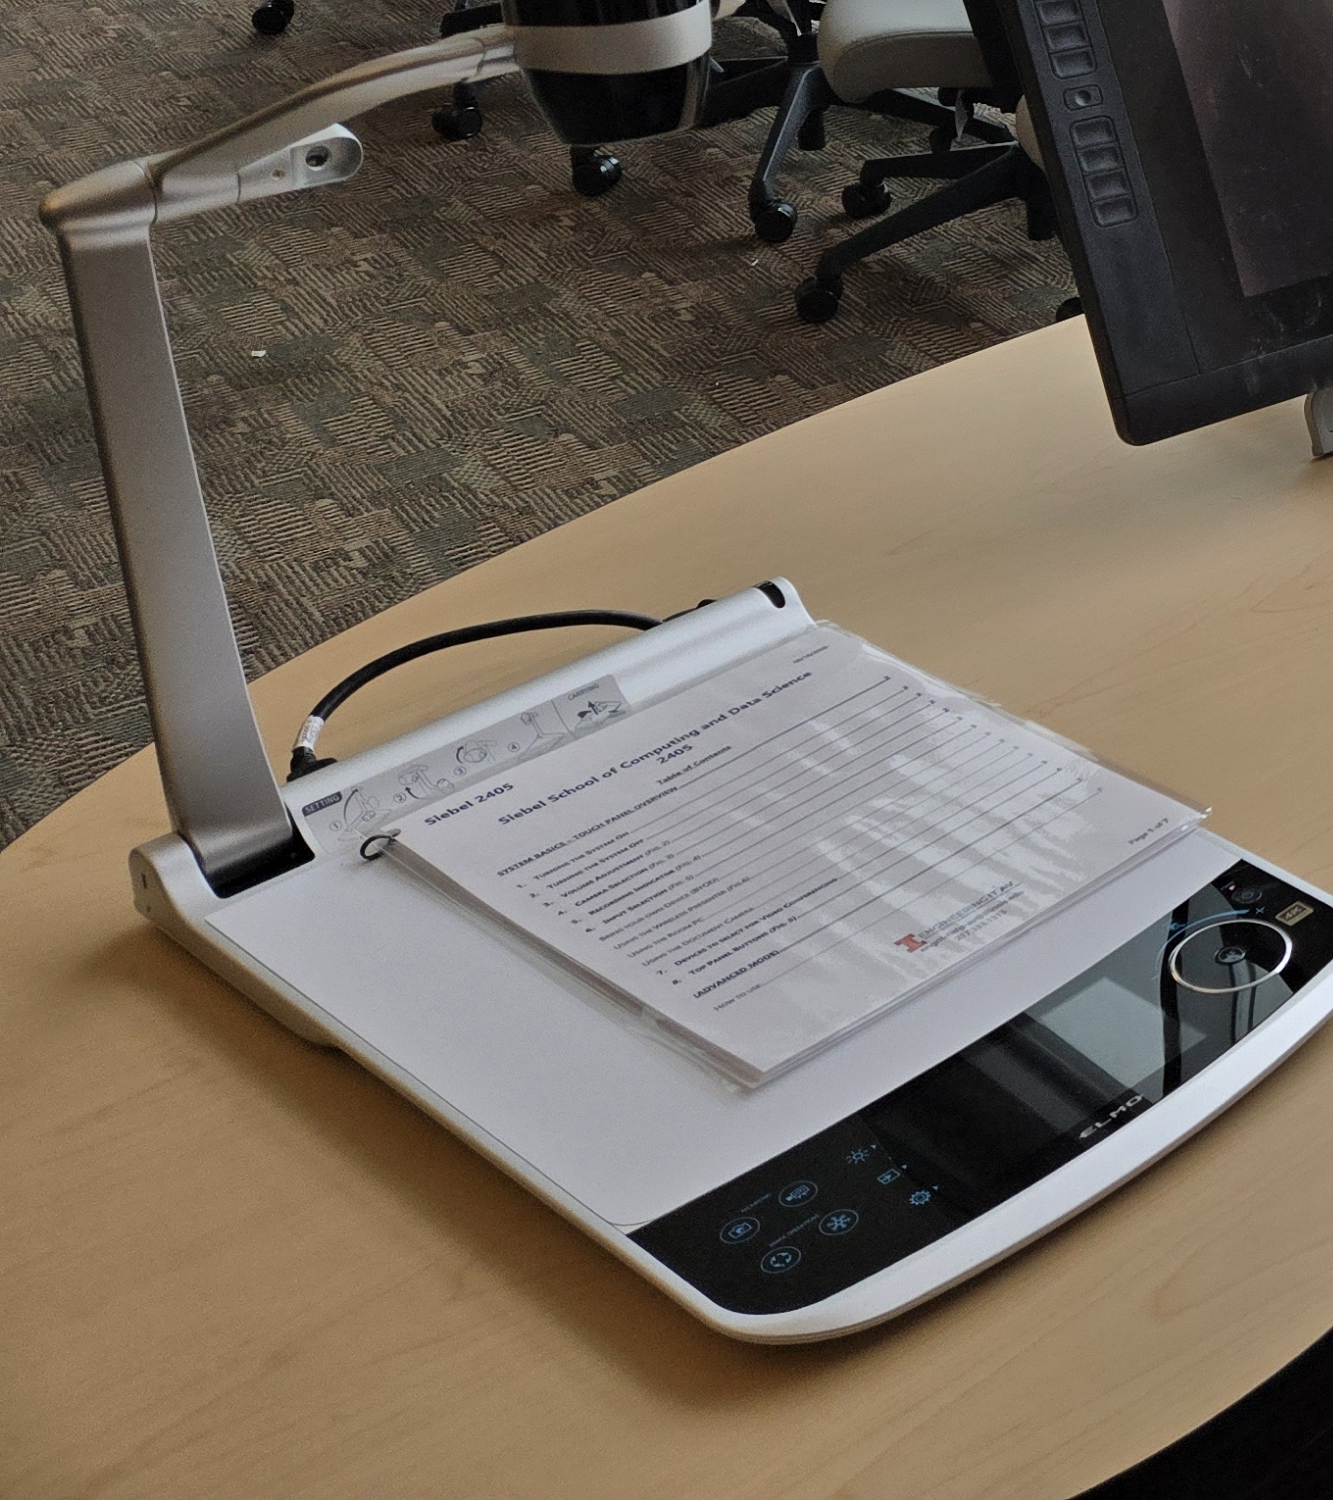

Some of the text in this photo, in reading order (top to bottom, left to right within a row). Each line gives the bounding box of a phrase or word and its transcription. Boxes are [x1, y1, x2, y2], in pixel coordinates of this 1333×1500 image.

[498, 672, 812, 825] Siebel School of Computing and Data Science
[656, 744, 693, 764] 2405
[656, 745, 732, 785] Table of Contents
[304, 793, 341, 814] SETTING
[424, 783, 514, 826] Siebel 2405
[497, 857, 534, 877] SYSTEM
[533, 841, 568, 860] BASICS
[572, 822, 606, 840] TOUCH
[604, 809, 635, 825] PANEL
[633, 786, 678, 811] OVERVIEW
[1078, 1094, 1145, 1139] ELMO
